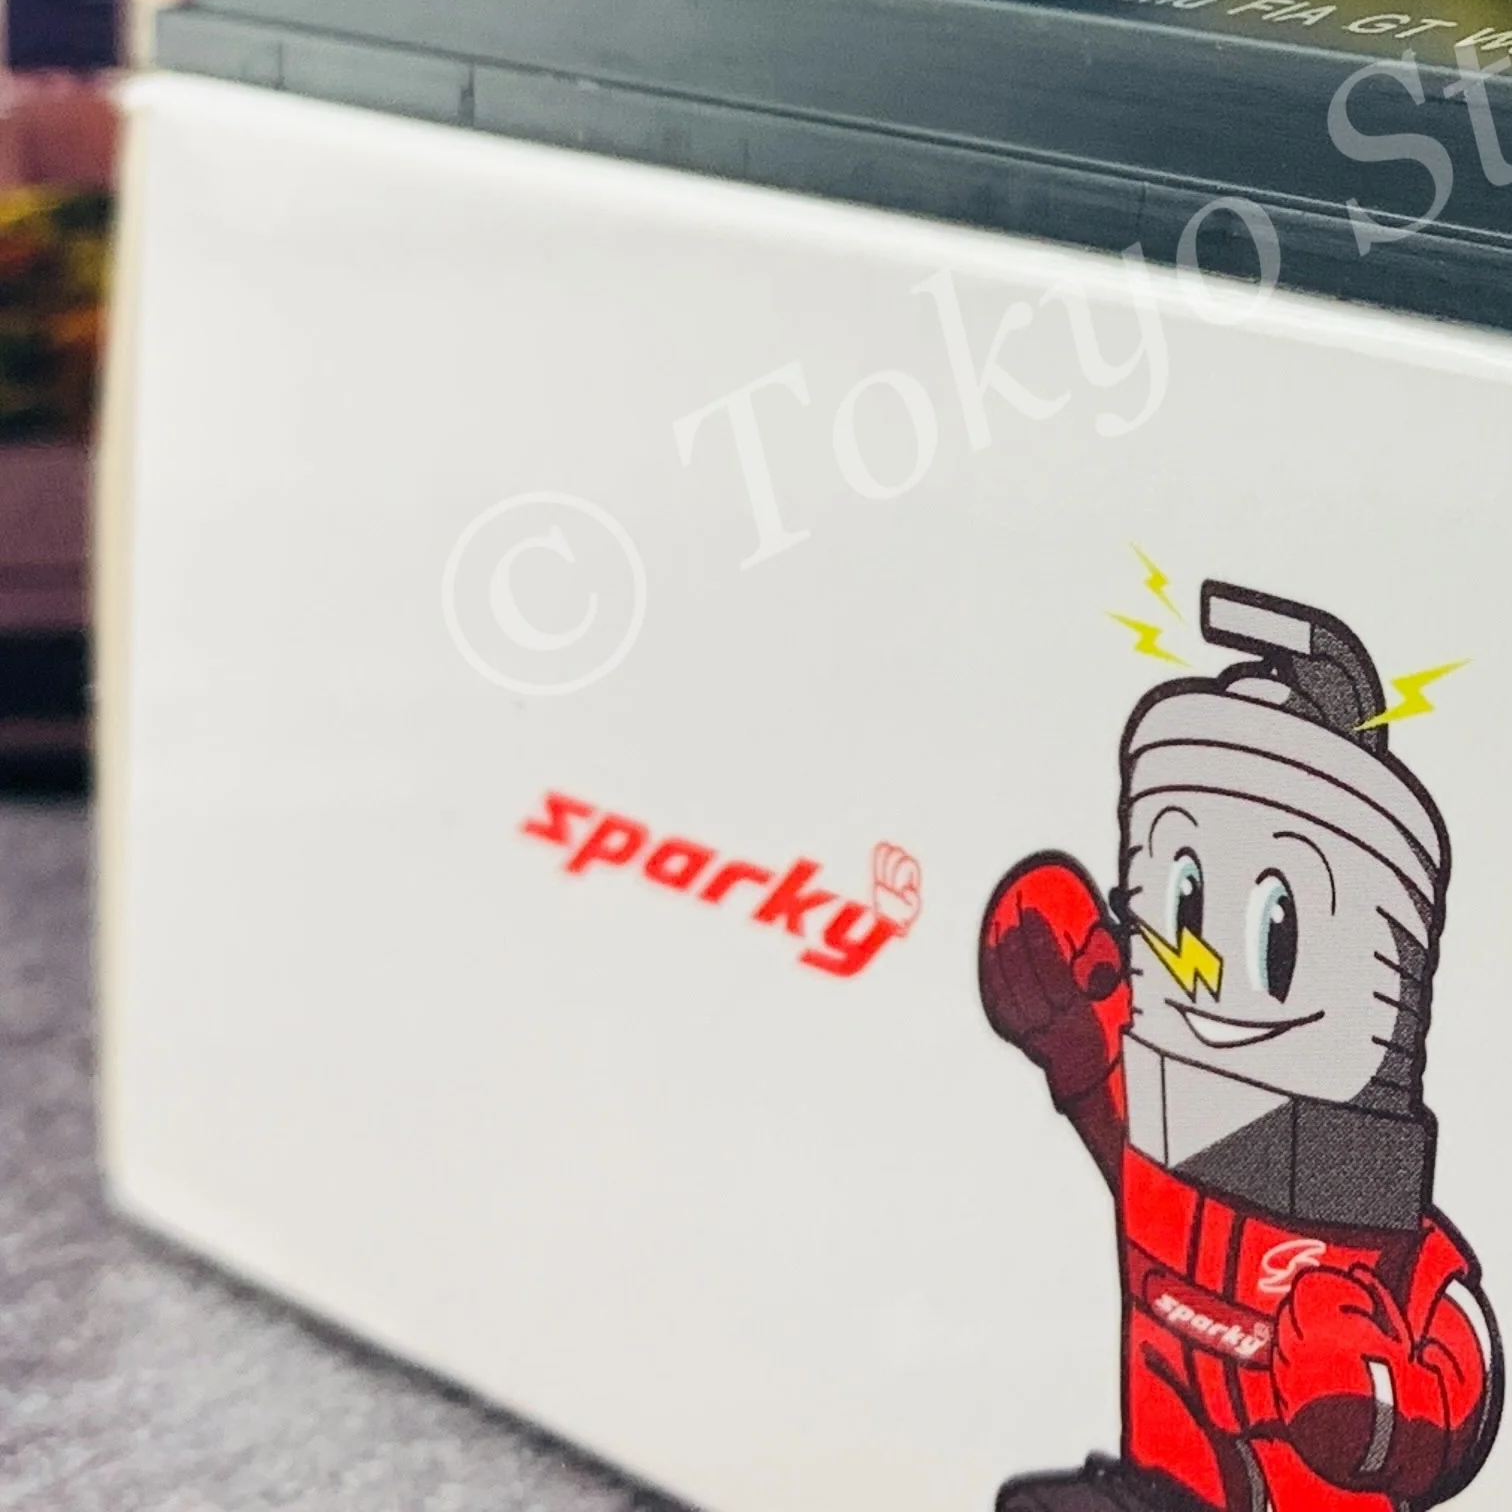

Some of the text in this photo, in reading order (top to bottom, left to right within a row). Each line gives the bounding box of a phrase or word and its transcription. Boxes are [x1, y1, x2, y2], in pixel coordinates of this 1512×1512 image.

[1346, 13, 1458, 40] GT
[519, 788, 902, 978] sparky
[1151, 1292, 1264, 1359] sparky
